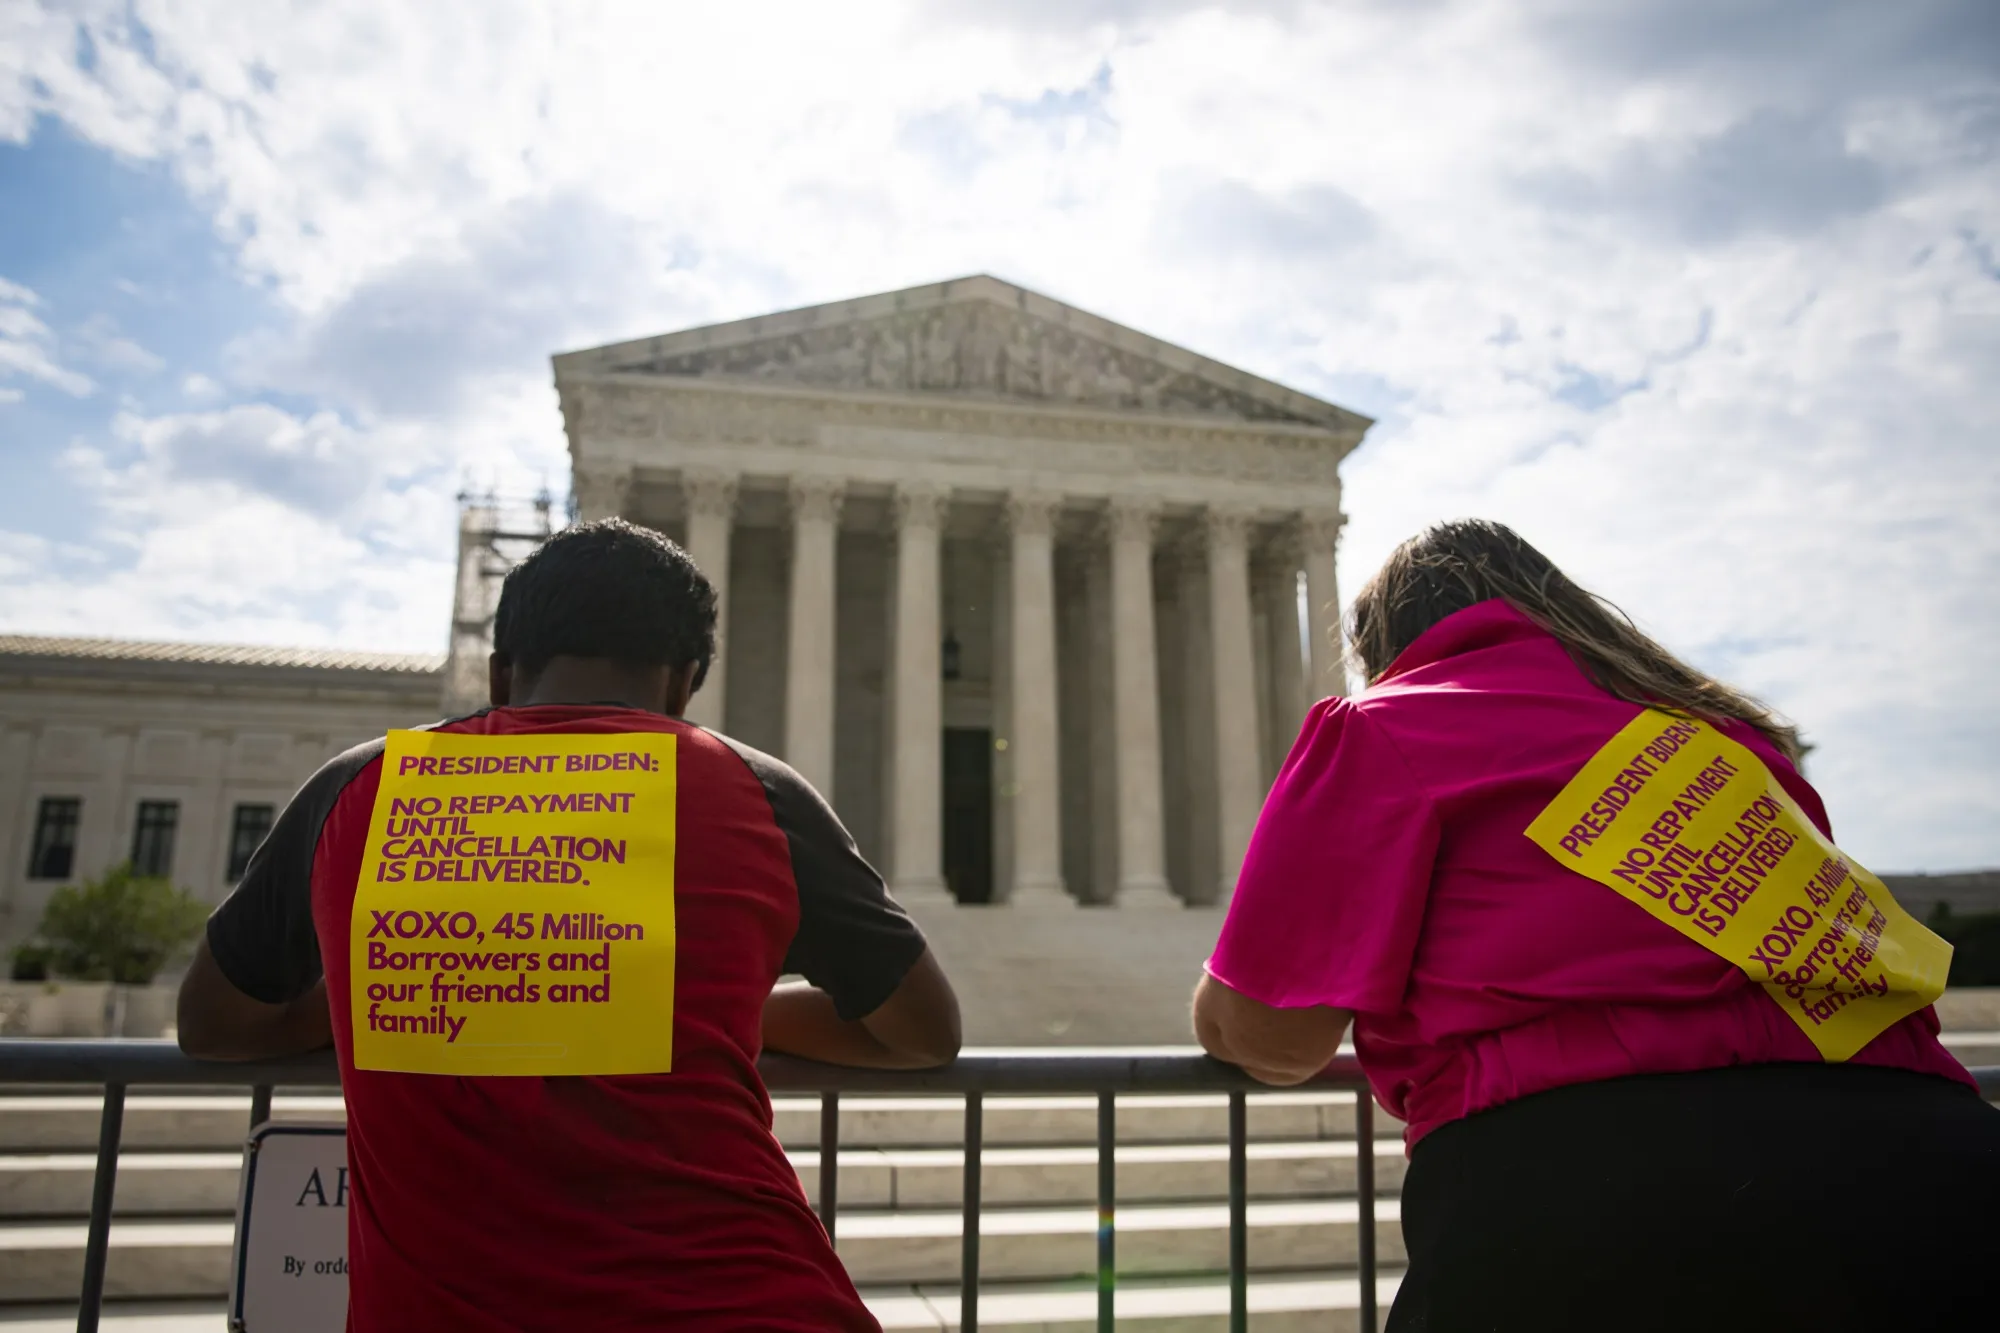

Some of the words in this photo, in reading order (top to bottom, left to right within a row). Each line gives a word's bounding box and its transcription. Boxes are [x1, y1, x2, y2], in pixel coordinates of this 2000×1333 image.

[399, 755, 560, 776] PRESIDENT
[565, 752, 660, 773] BIDEN:
[390, 797, 442, 816] NO
[448, 793, 635, 814] REPAYMENT
[1558, 754, 1659, 858] PRESIDENT
[1643, 720, 1700, 764] BIDEN:
[385, 816, 475, 837] UNTIL
[1611, 847, 1655, 885] NO
[1640, 755, 1739, 851] REPAYMENT
[381, 835, 626, 864] CANCELLATION
[1668, 790, 1784, 916] CANCELLATION
[376, 860, 407, 882] IS
[413, 859, 591, 886] DELIVERED.
[1637, 842, 1704, 900] UNTIL
[1845, 876, 1868, 915] and
[366, 910, 485, 944] XOXO,
[492, 913, 535, 940] 45
[541, 913, 644, 941] Million
[1692, 908, 1726, 937] IS
[1748, 905, 1823, 977] XOXO,
[1804, 880, 1831, 908] 45
[367, 942, 540, 971] Borrowers
[547, 942, 610, 972] and
[1832, 926, 1880, 984] friends
[1866, 899, 1888, 938] and
[366, 982, 423, 1003] our
[430, 972, 540, 1003] friends
[547, 972, 610, 1003] and
[367, 1005, 467, 1042] family
[283, 1255, 306, 1278] By
